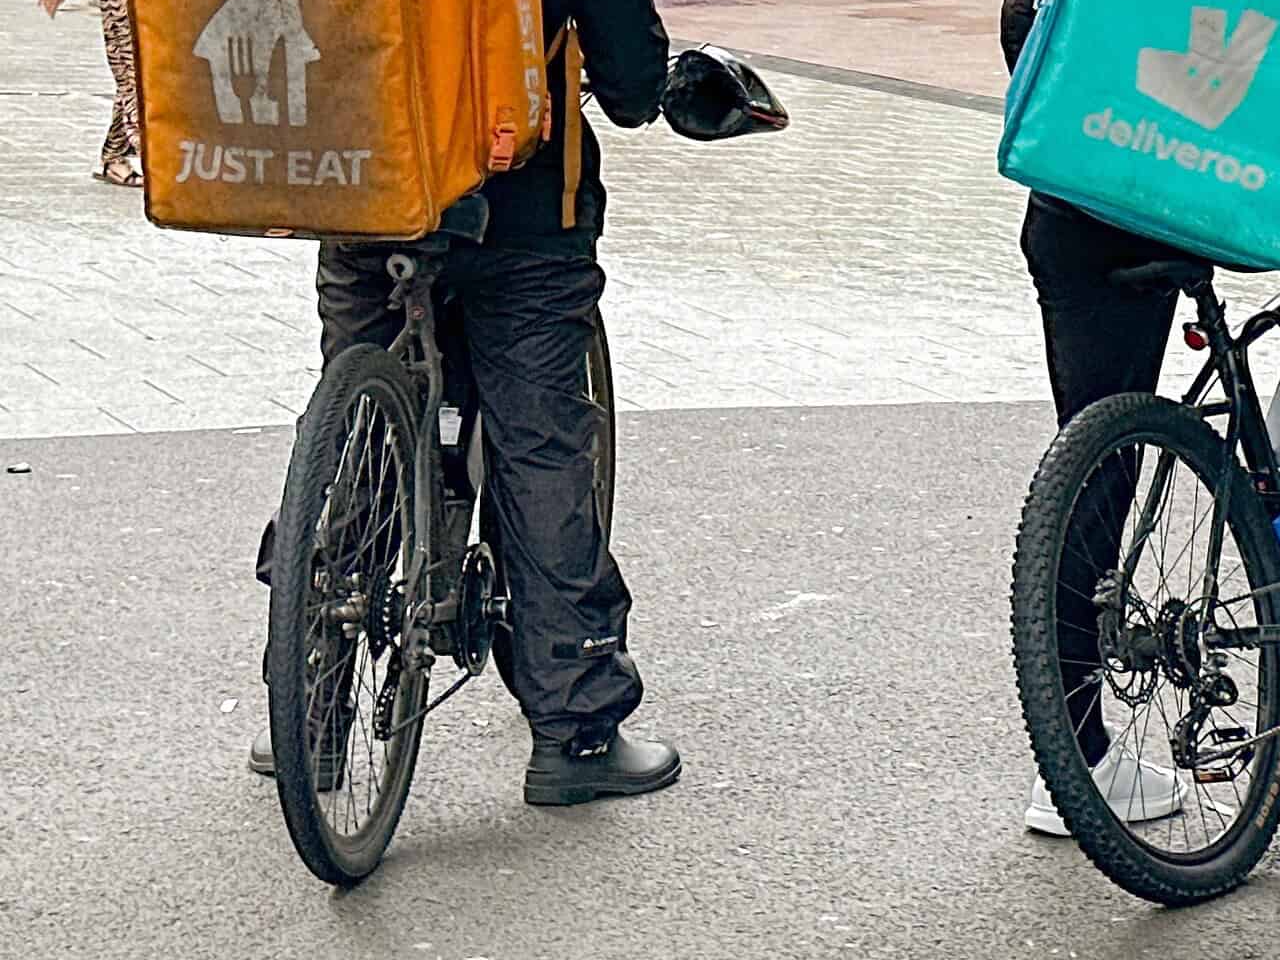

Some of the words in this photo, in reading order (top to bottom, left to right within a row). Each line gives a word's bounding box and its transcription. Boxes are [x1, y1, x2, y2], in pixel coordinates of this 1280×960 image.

[176, 140, 273, 185] JUST
[287, 148, 372, 185] EAT
[1082, 108, 1268, 192] deliveroo
